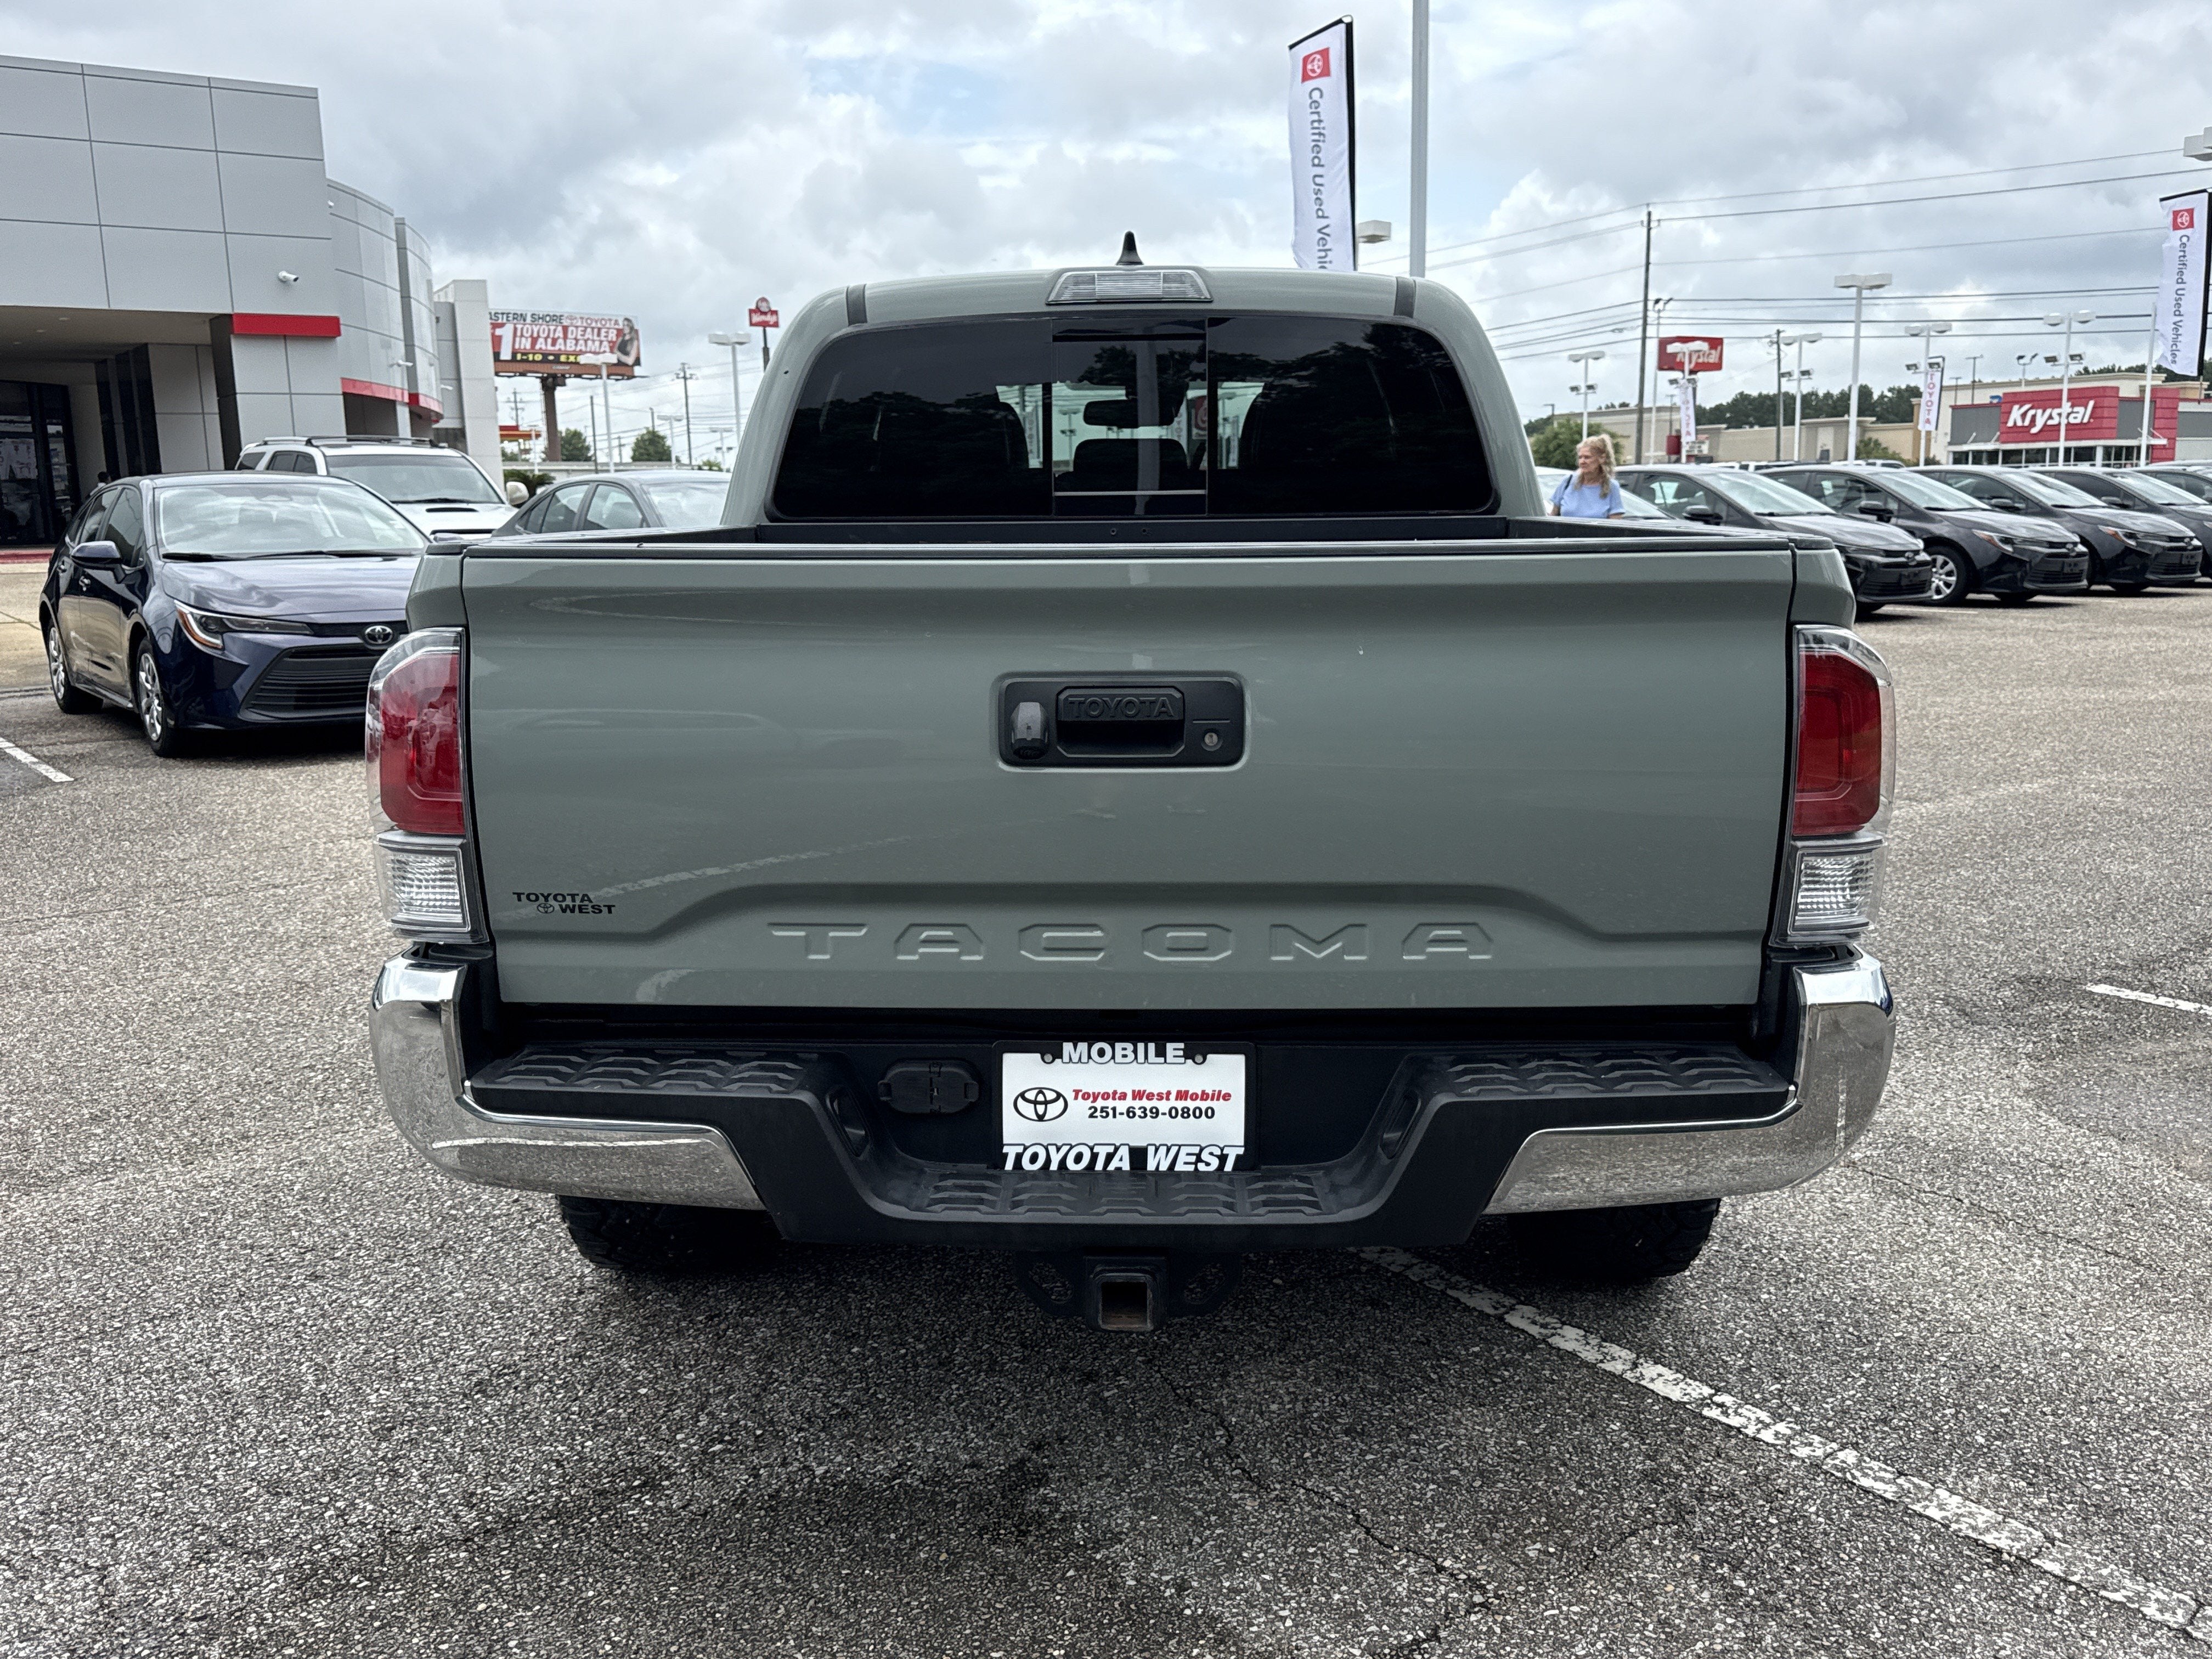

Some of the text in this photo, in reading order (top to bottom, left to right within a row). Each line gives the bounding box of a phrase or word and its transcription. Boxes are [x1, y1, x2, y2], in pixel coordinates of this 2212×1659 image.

[1308, 87, 1327, 168] Certified
[1312, 174, 1330, 220] Used
[2170, 234, 2190, 365] Certified Used Vehicles
[530, 314, 564, 324] SHORE
[579, 317, 620, 327] TOYOTA
[514, 337, 532, 349] IN
[515, 324, 617, 341] TOYOTA DEALER
[1924, 373, 1936, 425] TOYOTA
[1068, 697, 1174, 718] TOYOTA
[512, 892, 594, 904] TOYOTA
[558, 904, 616, 915] WEST
[768, 922, 1494, 961] TACOMA
[1062, 1042, 1186, 1064] MOBILE
[1072, 1089, 1232, 1103] Toyota West Mobile
[1087, 1105, 1216, 1120] 251-639-0800
[1002, 1144, 1245, 1172] TOYOTA WEST
